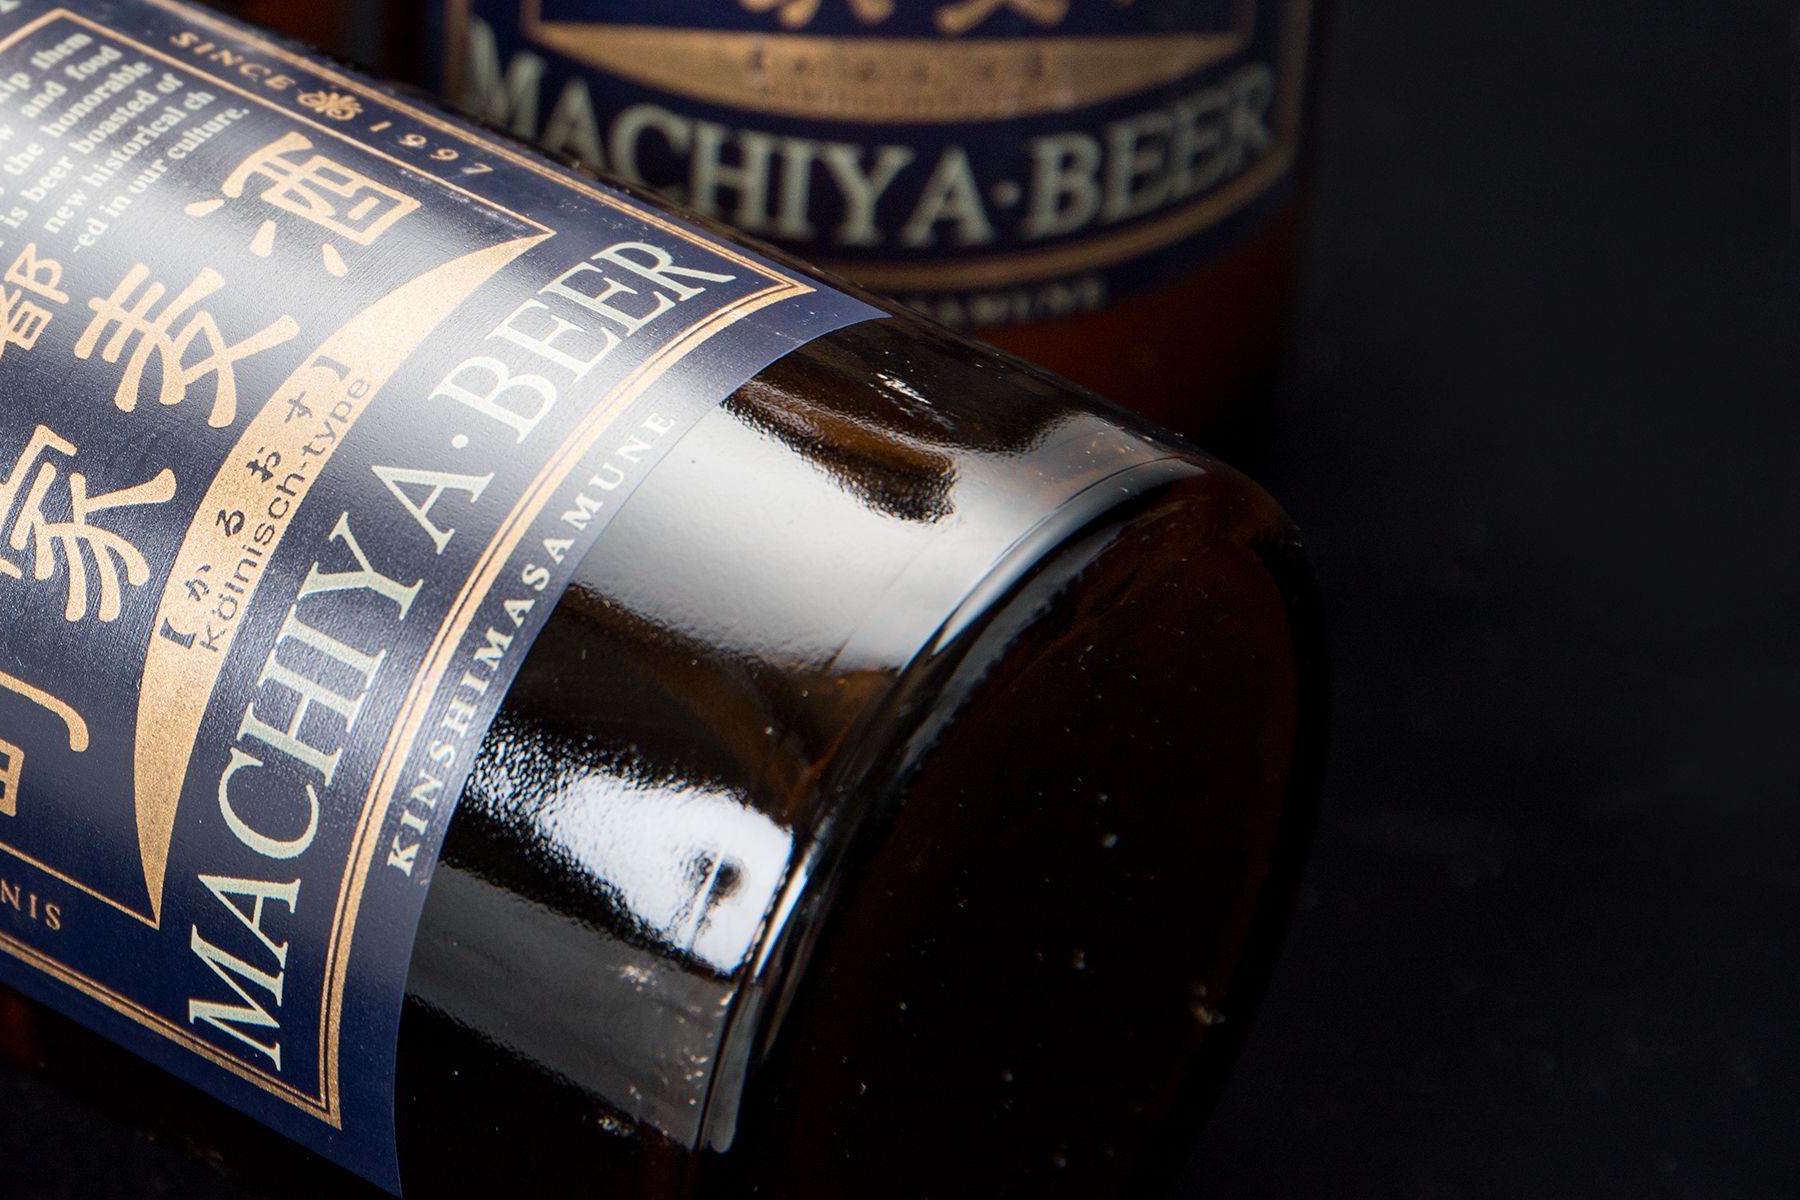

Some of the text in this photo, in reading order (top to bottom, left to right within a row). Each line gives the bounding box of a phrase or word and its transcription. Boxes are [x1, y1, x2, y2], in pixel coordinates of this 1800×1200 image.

[3, 140, 46, 177] the
[39, 60, 152, 139] honorable
[20, 79, 68, 119] and
[64, 44, 123, 82] food
[30, 32, 93, 71] them
[170, 31, 494, 174] SINCE 1997
[0, 204, 29, 229] is
[20, 154, 75, 203] beer
[68, 88, 159, 154] boasted
[155, 72, 184, 94] of
[42, 188, 90, 235] new
[81, 103, 188, 188] historical
[183, 88, 216, 111] ch
[99, 194, 132, 218] in
[127, 157, 169, 194] our
[166, 107, 251, 161] culture.
[199, 377, 371, 653] Kölnisch-type
[386, 410, 677, 878] KINSHIMASAMUNE
